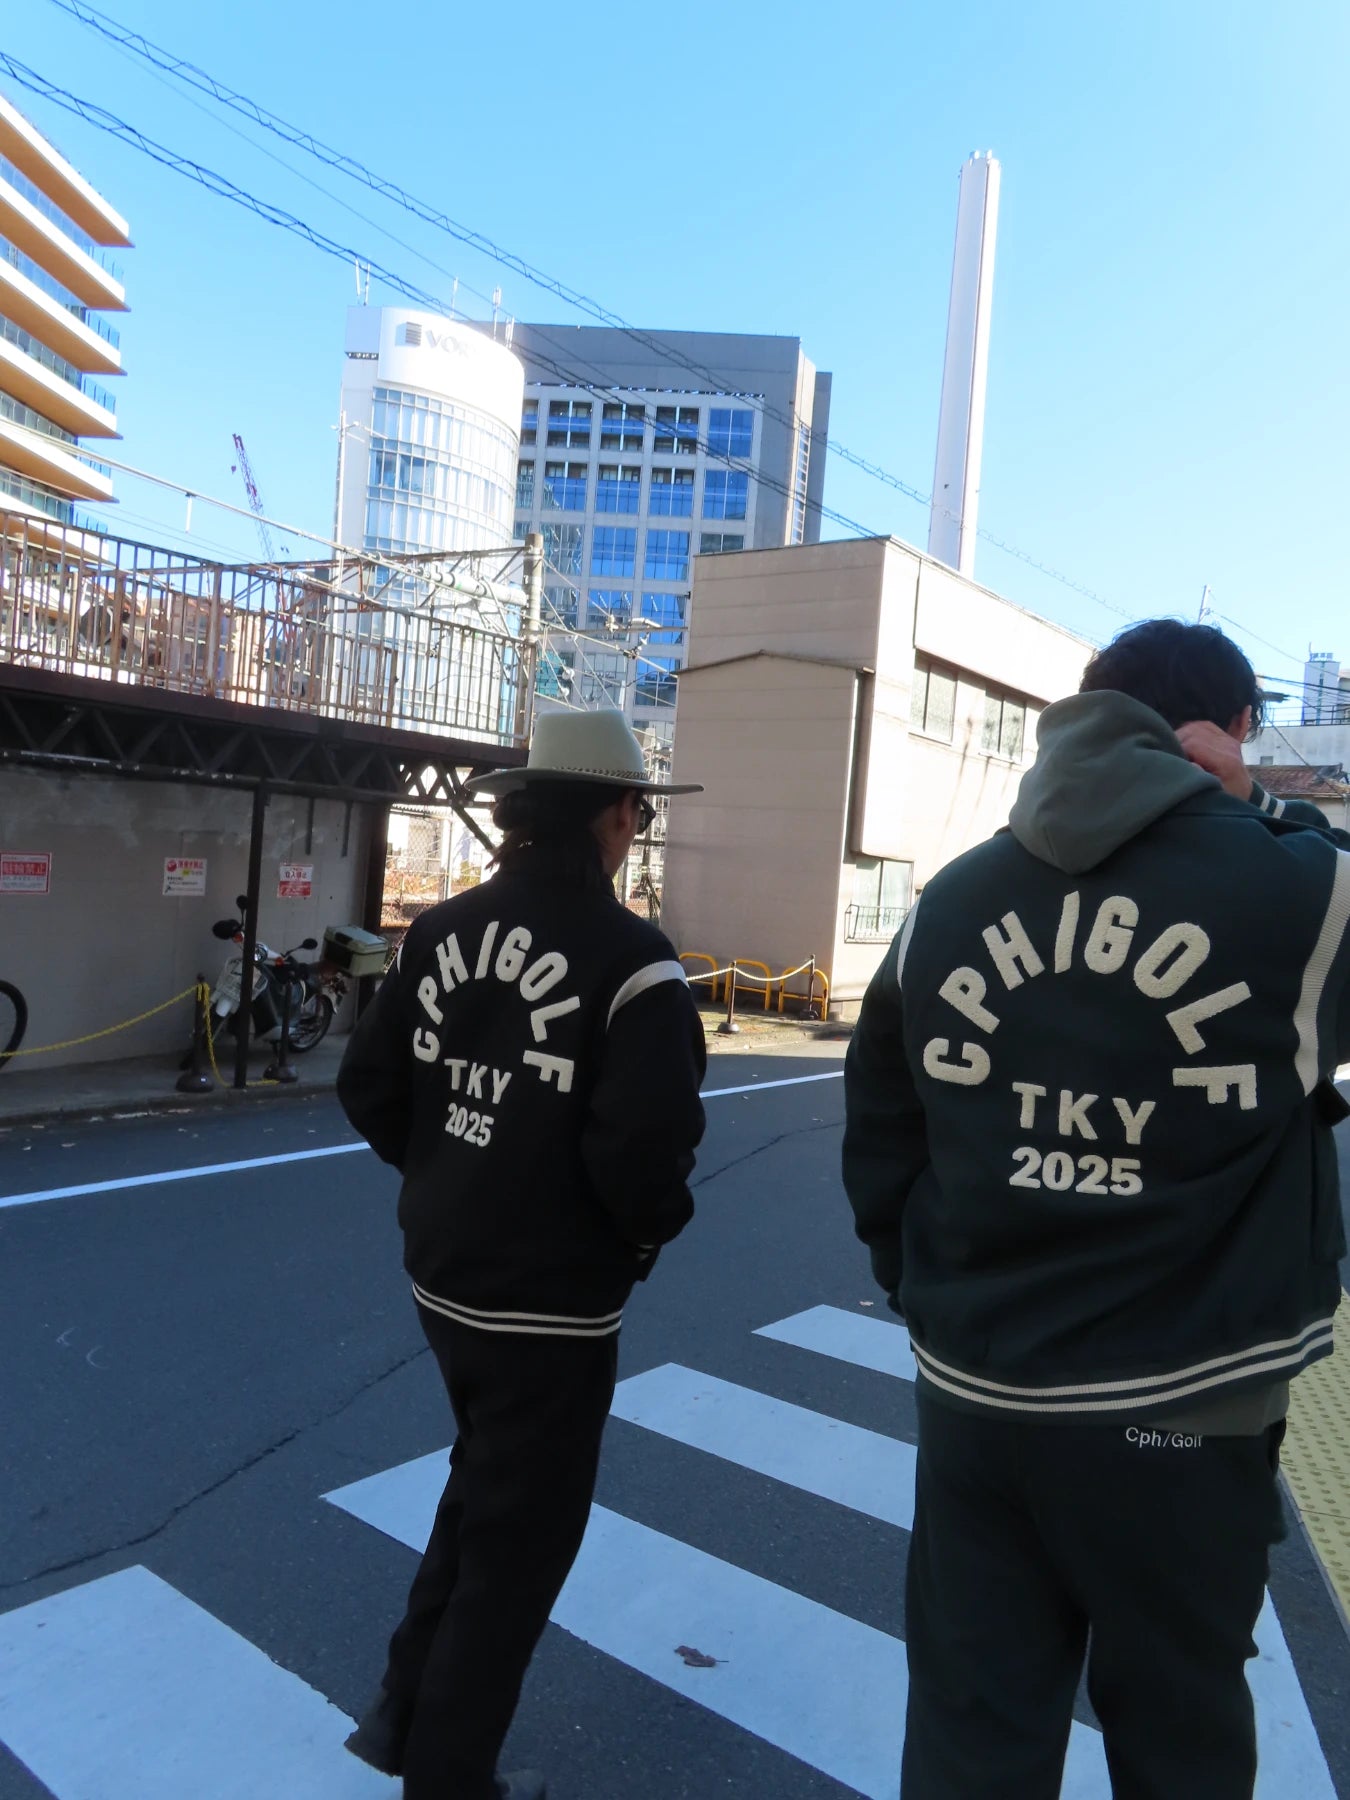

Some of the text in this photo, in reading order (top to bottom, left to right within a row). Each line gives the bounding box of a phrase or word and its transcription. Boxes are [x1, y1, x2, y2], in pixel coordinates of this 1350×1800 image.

[444, 1058, 512, 1105] TKY
[445, 1102, 495, 1148] 2025
[1012, 1081, 1156, 1145] TKY
[1009, 1146, 1143, 1197] 2025
